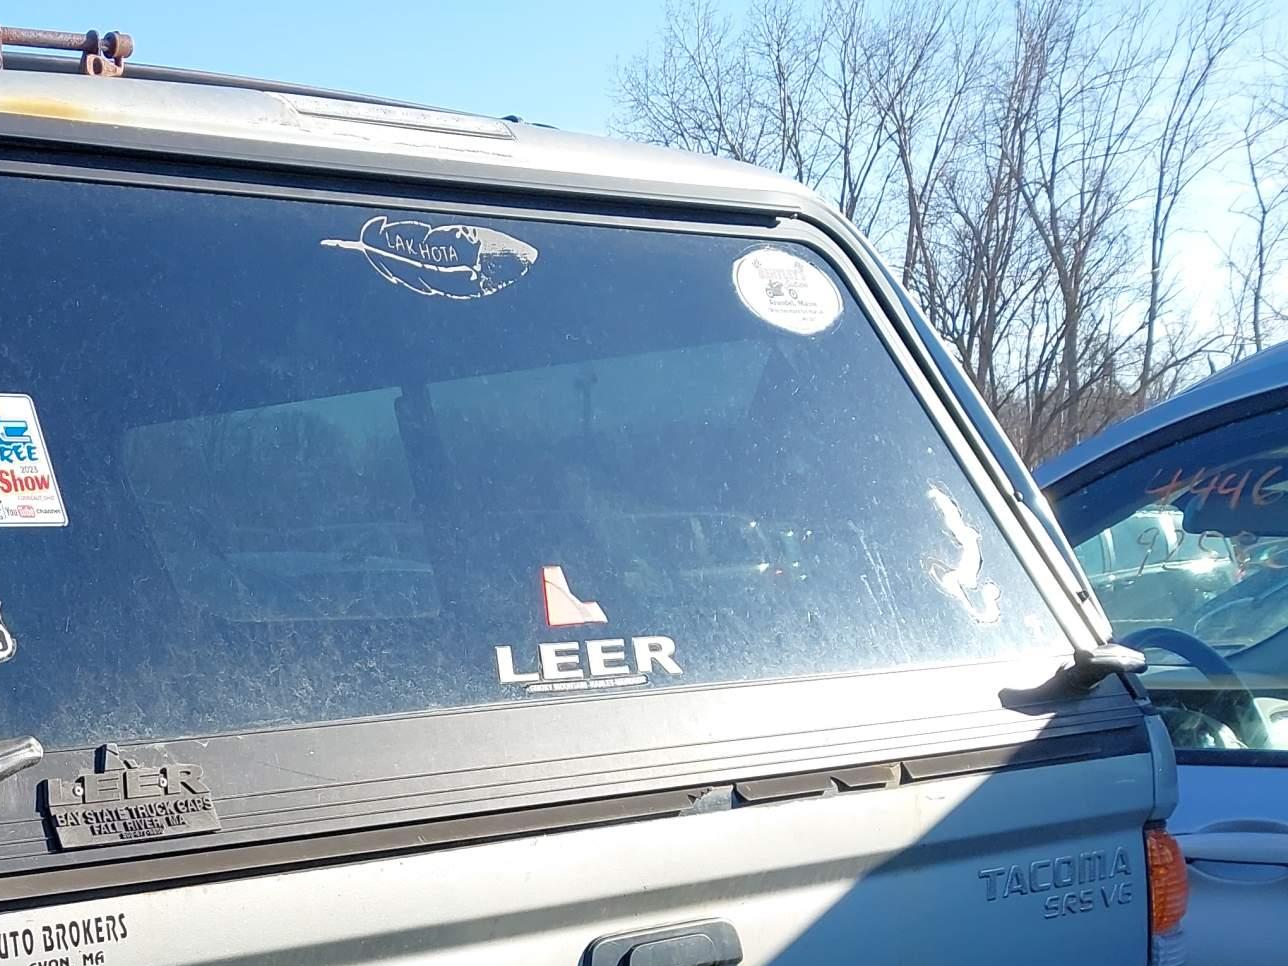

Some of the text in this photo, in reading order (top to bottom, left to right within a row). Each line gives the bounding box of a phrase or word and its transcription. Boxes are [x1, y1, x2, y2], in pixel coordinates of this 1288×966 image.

[494, 635, 684, 685] LEER
[42, 763, 210, 807] LEER
[56, 796, 213, 827] BAY STATE TRUCK CAPS
[92, 822, 119, 836] FALL
[168, 814, 186, 826] MA
[977, 846, 1132, 902] TACOMA
[1043, 882, 1134, 920] SR5 V6
[42, 912, 128, 953] BROKERS
[82, 951, 105, 966] MA
